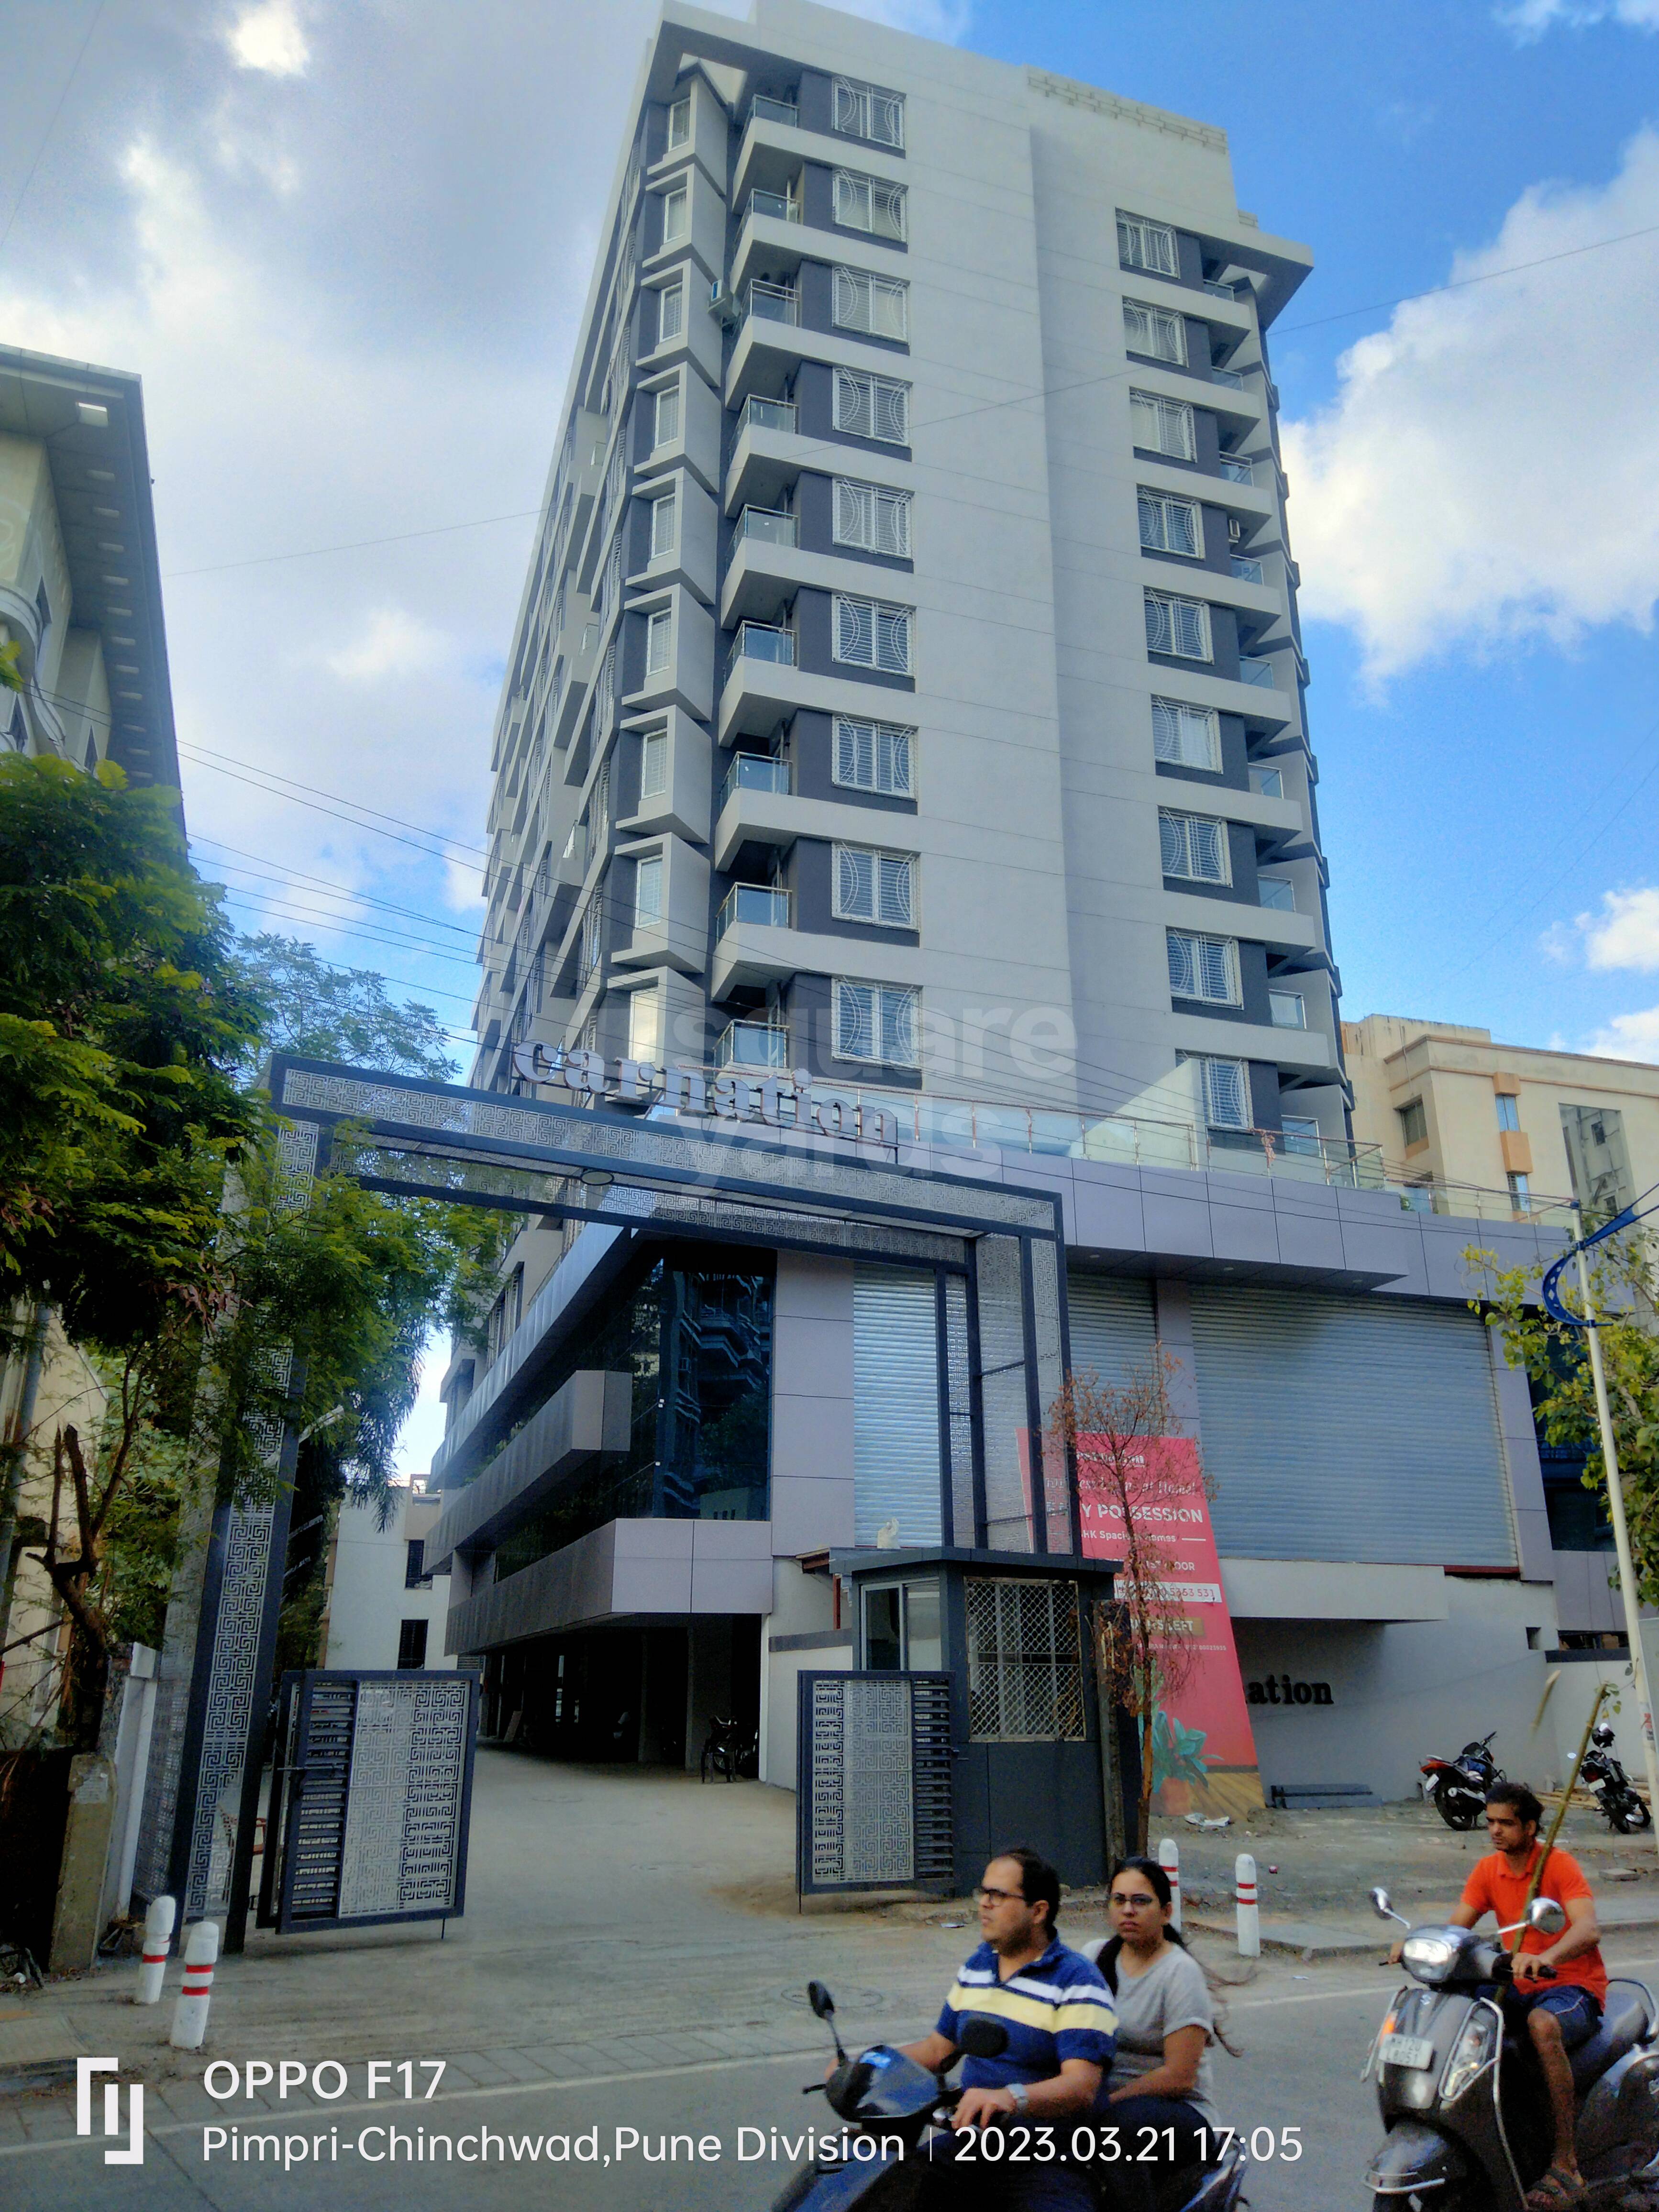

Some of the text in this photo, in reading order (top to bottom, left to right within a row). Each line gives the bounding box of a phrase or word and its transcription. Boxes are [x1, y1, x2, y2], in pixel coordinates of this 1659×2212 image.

[513, 1039, 900, 1150] carnation
[1082, 1530, 1097, 1539] HK
[1245, 1674, 1334, 1704] ation
